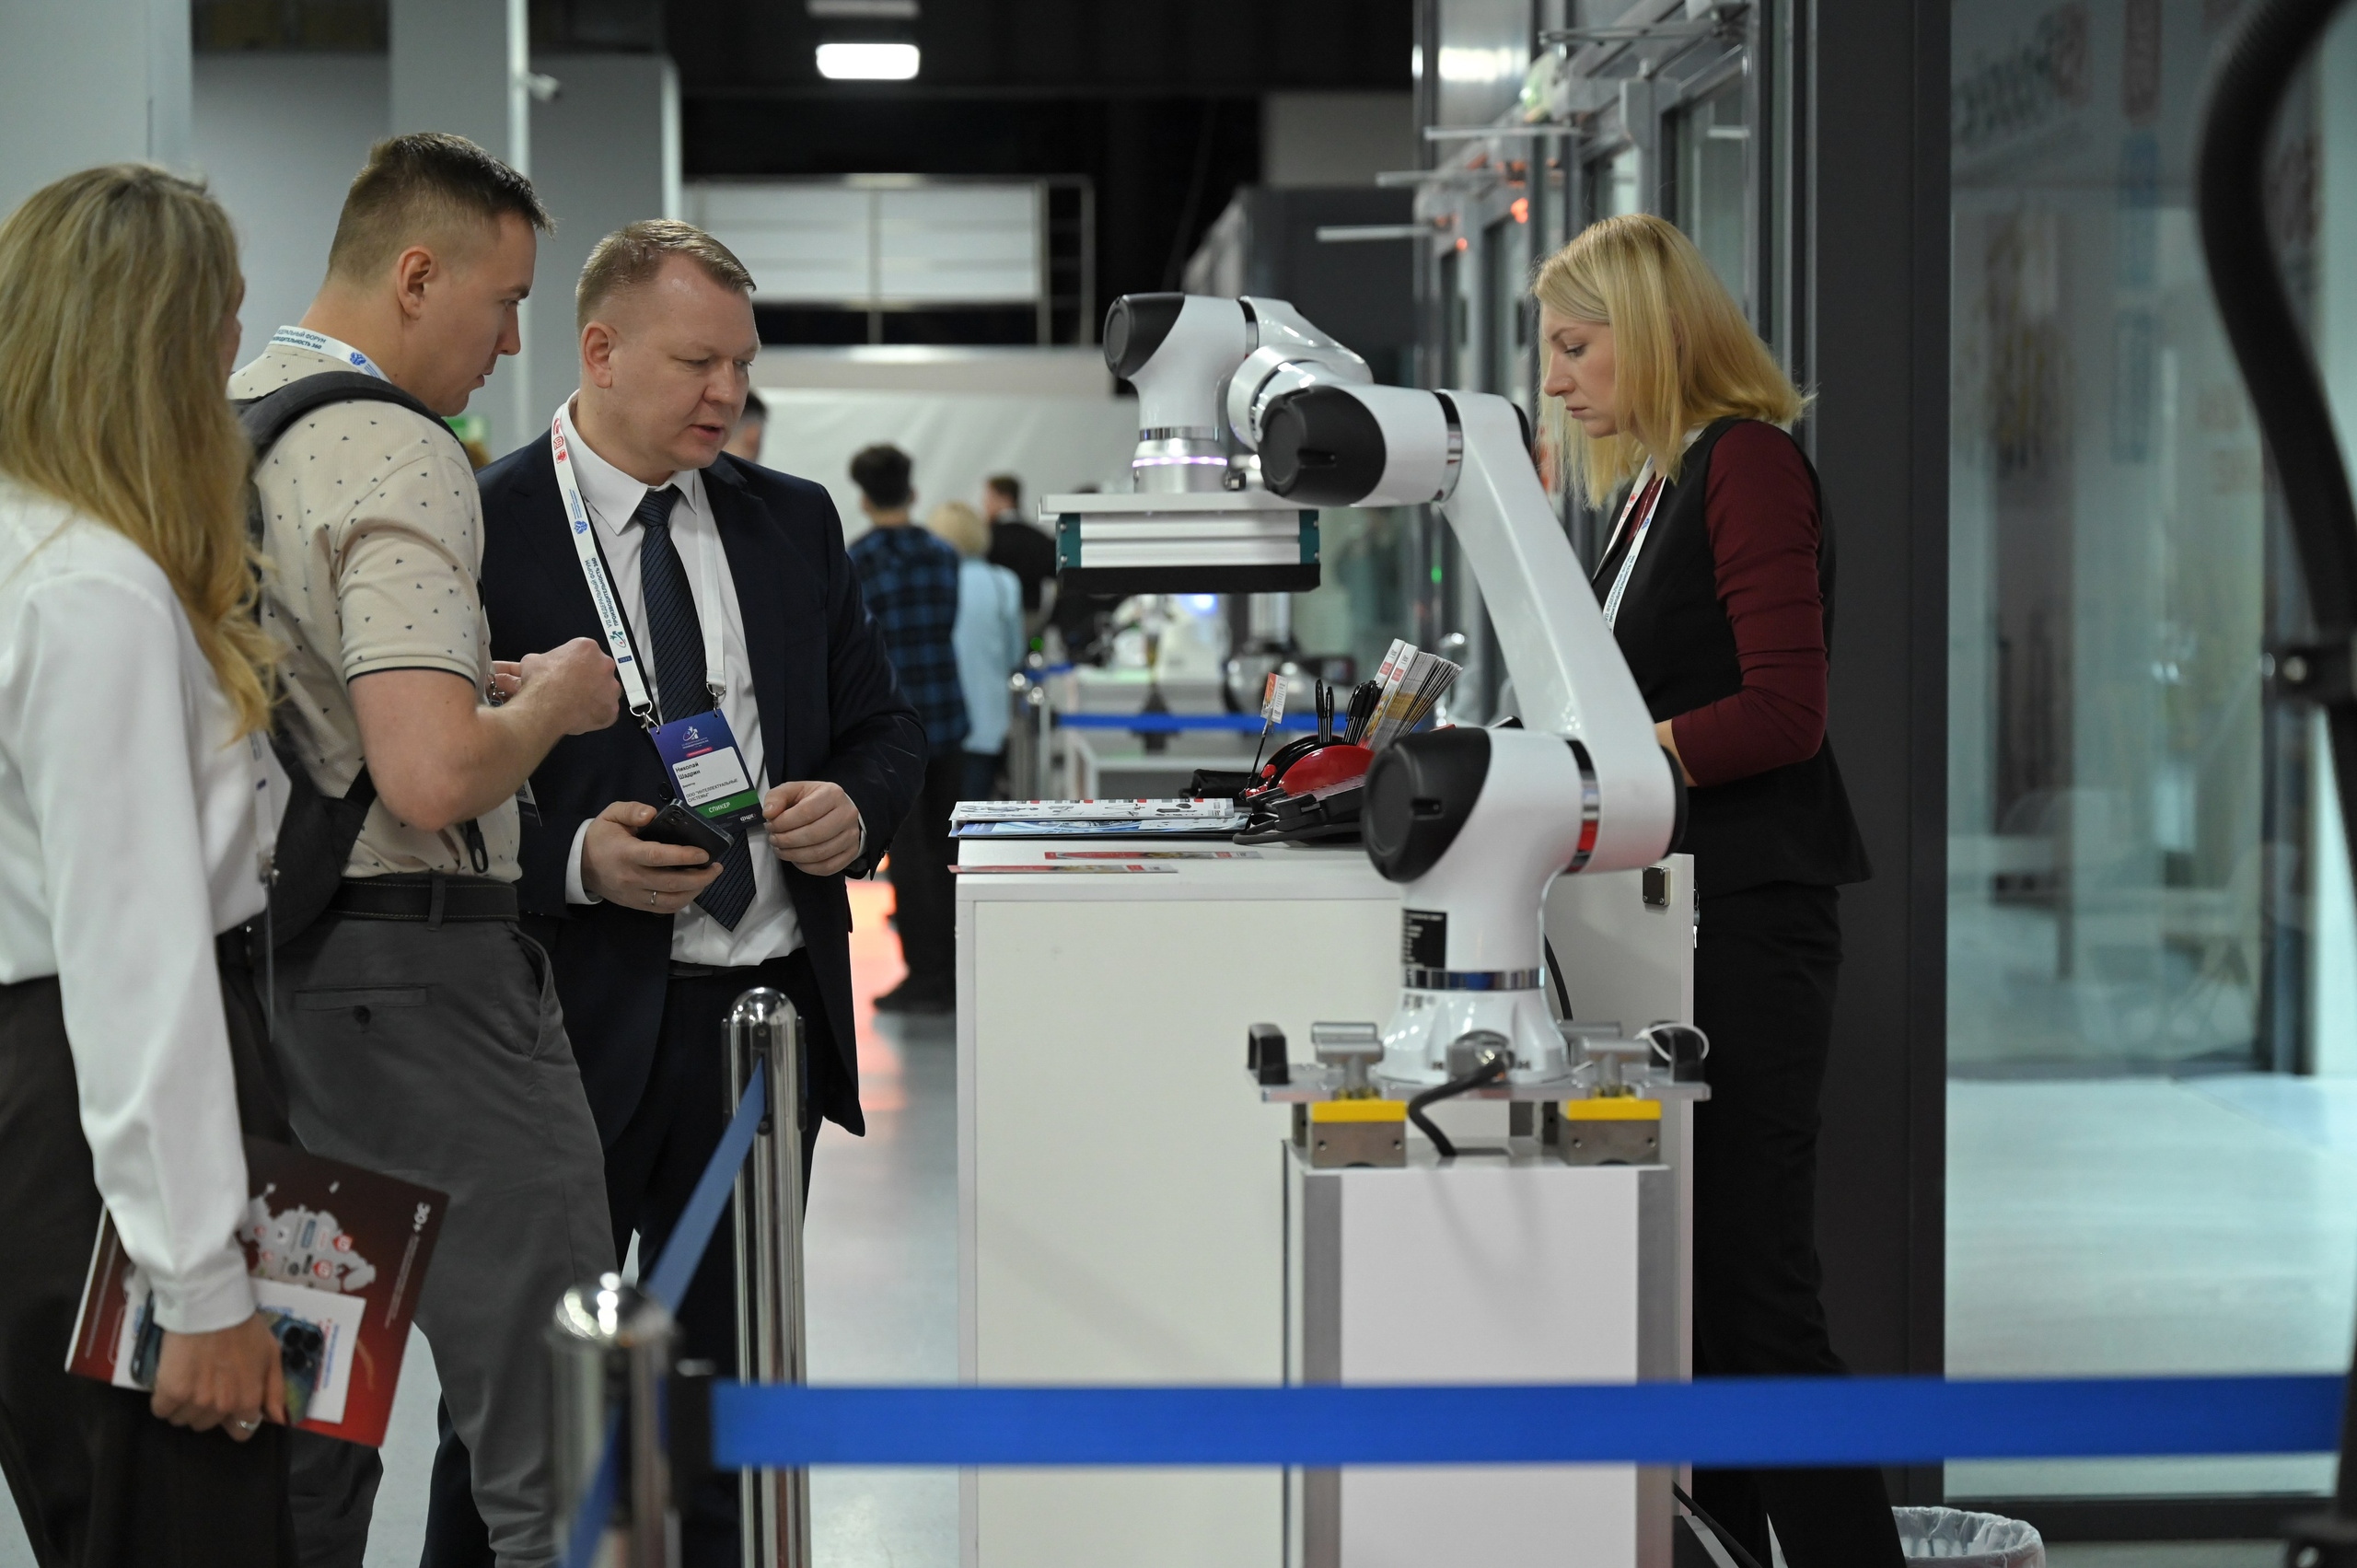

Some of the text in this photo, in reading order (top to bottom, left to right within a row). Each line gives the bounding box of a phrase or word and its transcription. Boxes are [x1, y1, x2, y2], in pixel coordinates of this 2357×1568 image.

[306, 333, 326, 343] ФОРУМ
[585, 560, 595, 580] ФОРУМ
[591, 580, 609, 619] ФЕДЕРАЛЬНЫЙ
[595, 567, 619, 626] ПРОИЗВОДИТЕЛЬНОСТЬ
[675, 761, 699, 772] Николай
[678, 770, 701, 780] Шадрин
[687, 793, 709, 803] СИСТЕМЫ"
[708, 802, 731, 813] СПИКЕР
